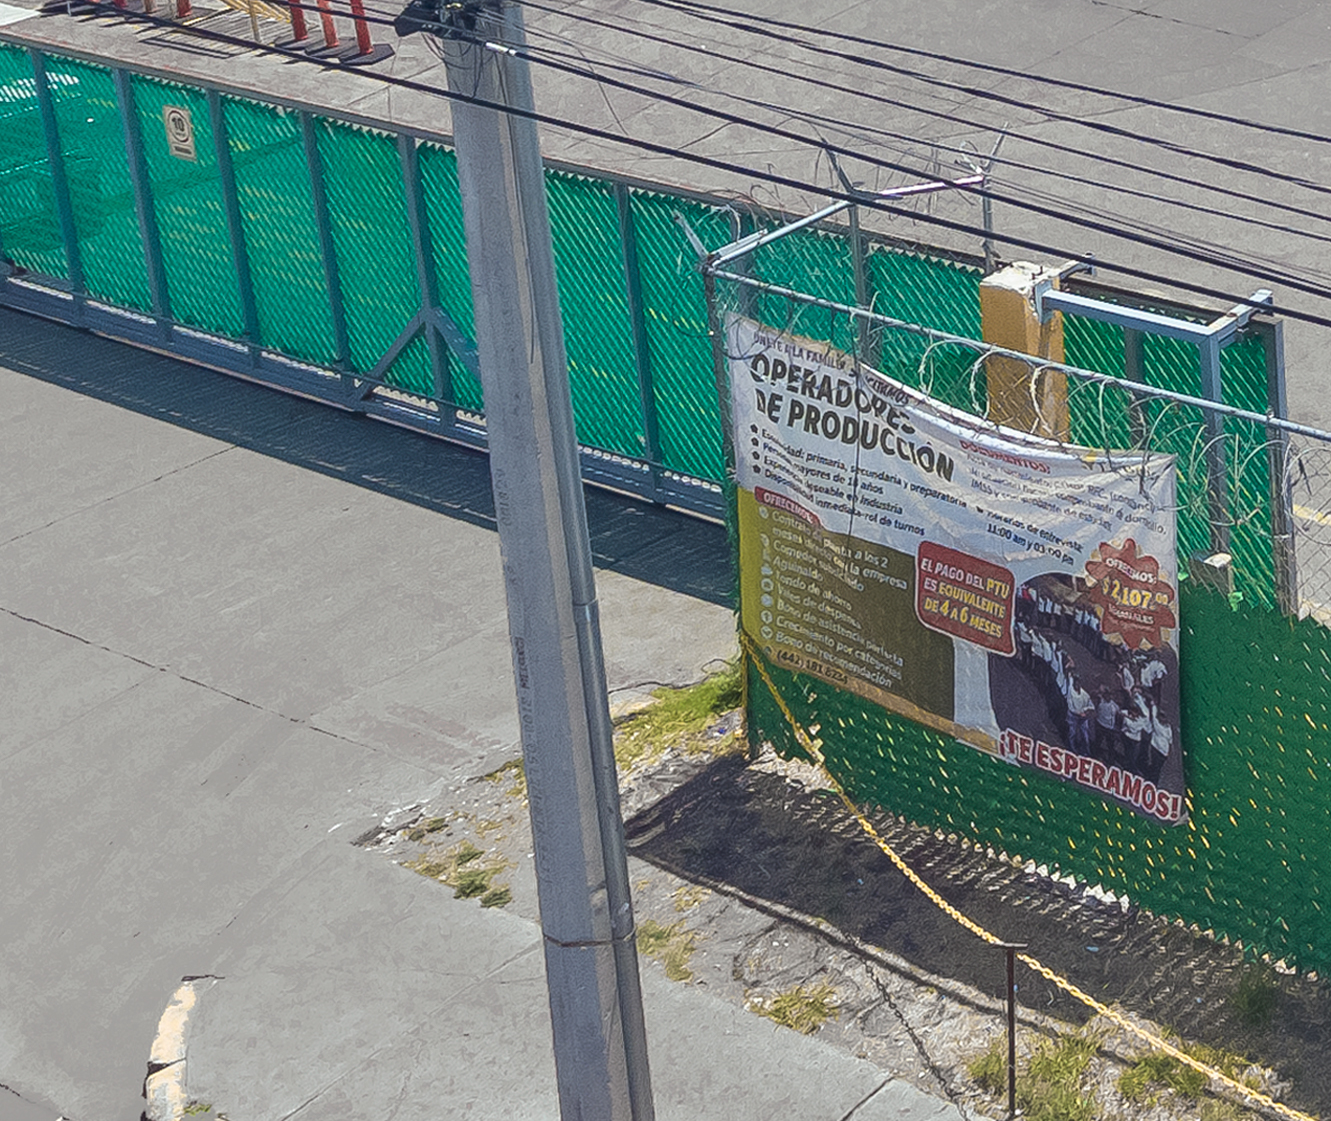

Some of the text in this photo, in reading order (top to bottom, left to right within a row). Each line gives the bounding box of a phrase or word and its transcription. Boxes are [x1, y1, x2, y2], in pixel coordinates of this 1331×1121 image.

[750, 353, 915, 435] OPERADORES
[787, 397, 955, 483] PRODUCCIÓN
[920, 558, 1010, 598] EL PAGO DEL PTU
[923, 576, 1006, 619] ES EQUIVALENTE
[924, 598, 939, 612] DE
[939, 600, 949, 617] 4
[959, 606, 969, 624] 6
[970, 615, 1002, 638] MESES
[1036, 741, 1182, 821] ESPERAMOS!
